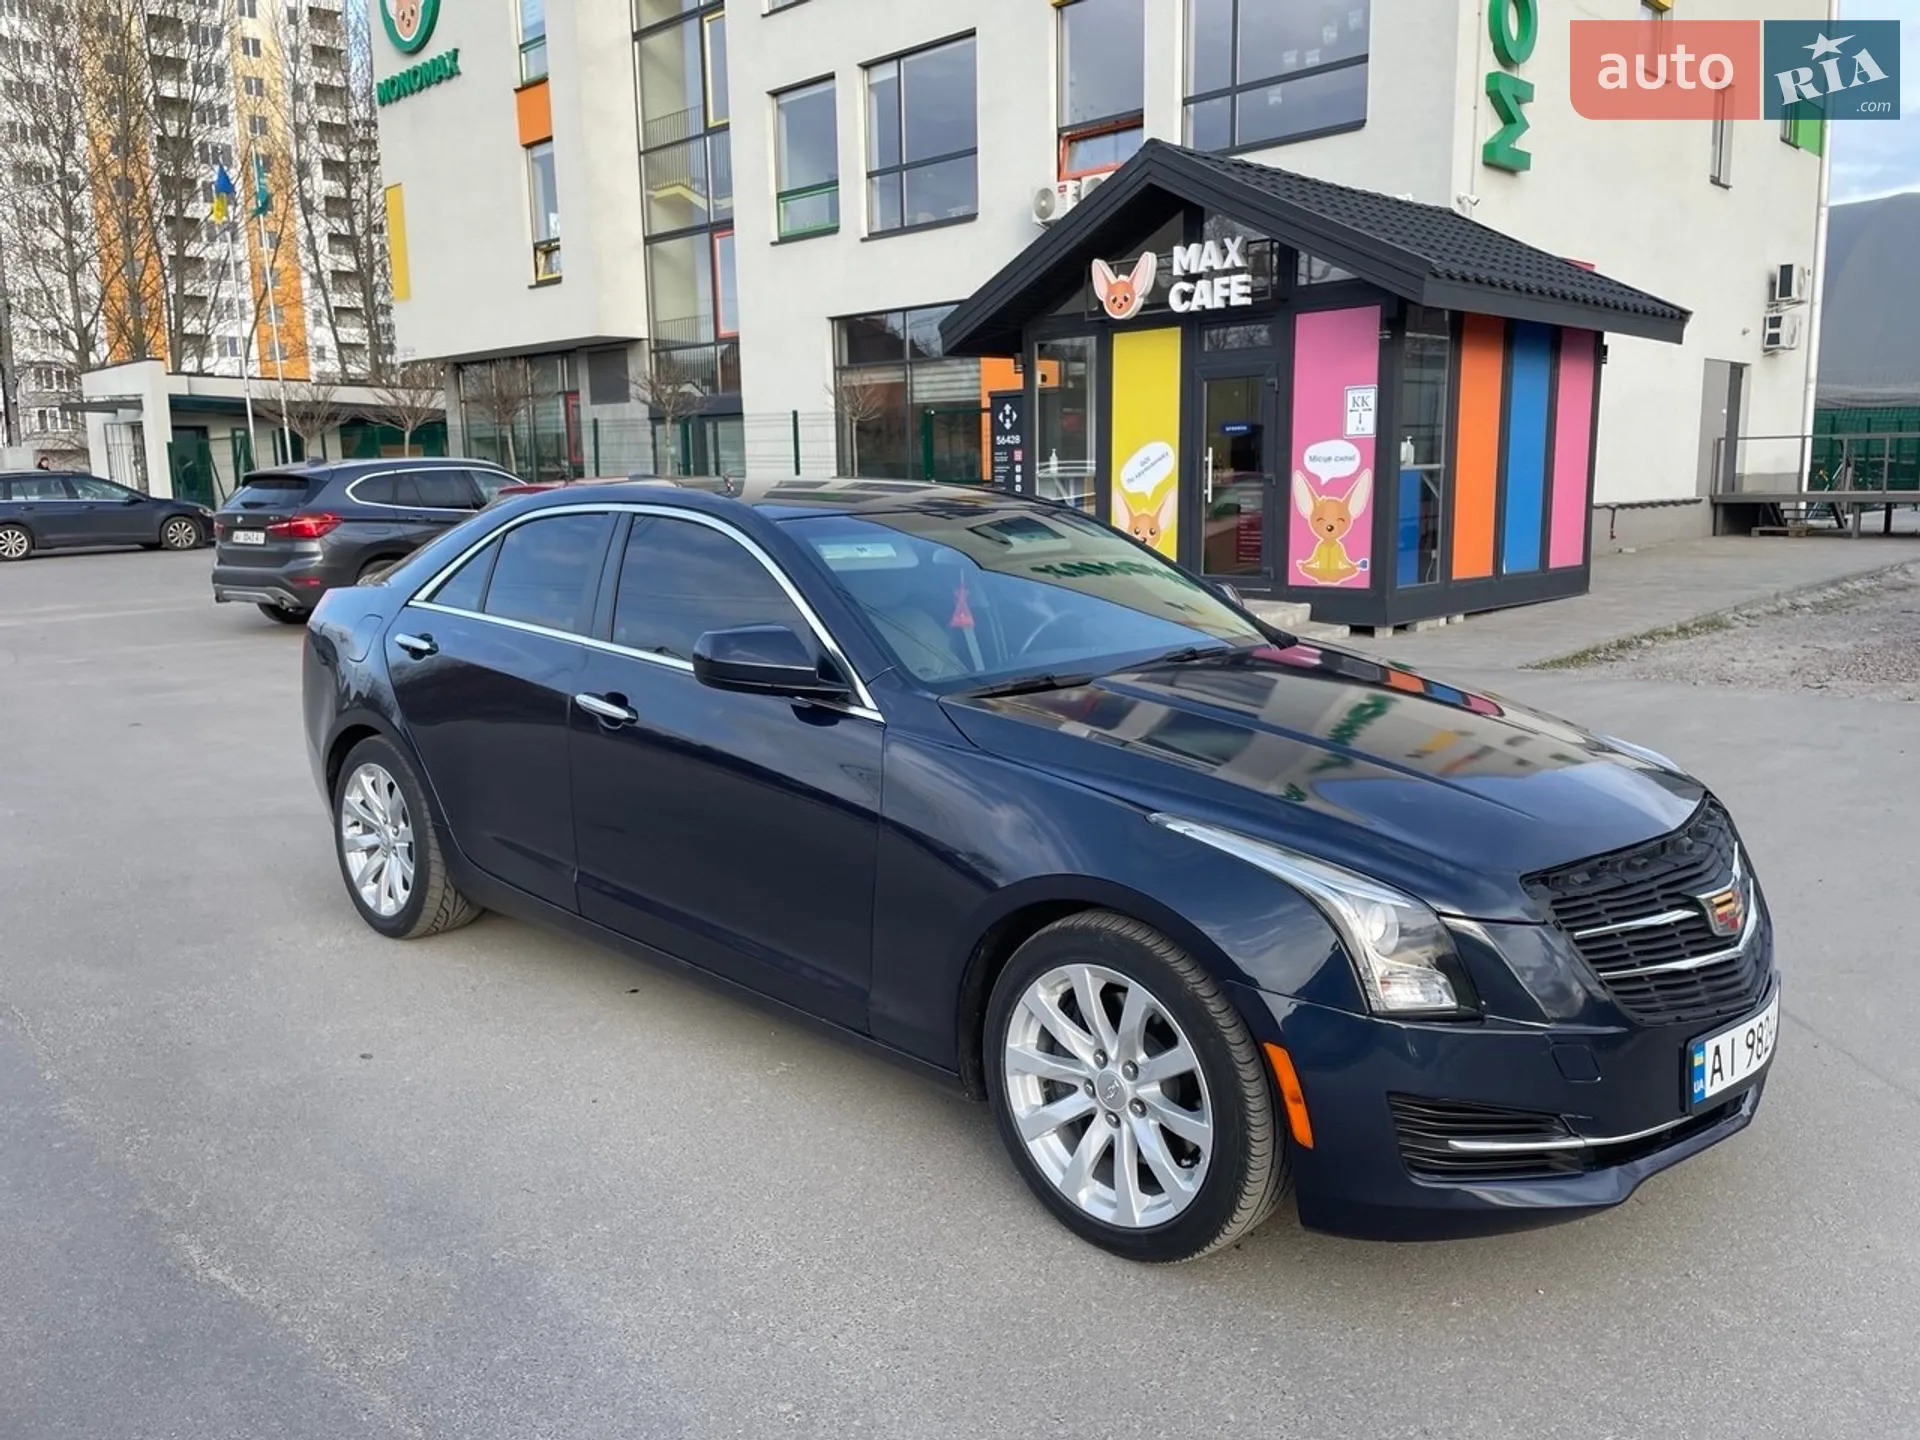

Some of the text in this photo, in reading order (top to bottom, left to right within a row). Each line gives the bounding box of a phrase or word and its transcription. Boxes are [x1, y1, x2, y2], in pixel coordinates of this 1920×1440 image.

[376, 47, 461, 107] MONOMAX
[1172, 235, 1248, 276] MAX
[1168, 274, 1252, 313] CAFE
[1693, 1078, 1705, 1094] UA
